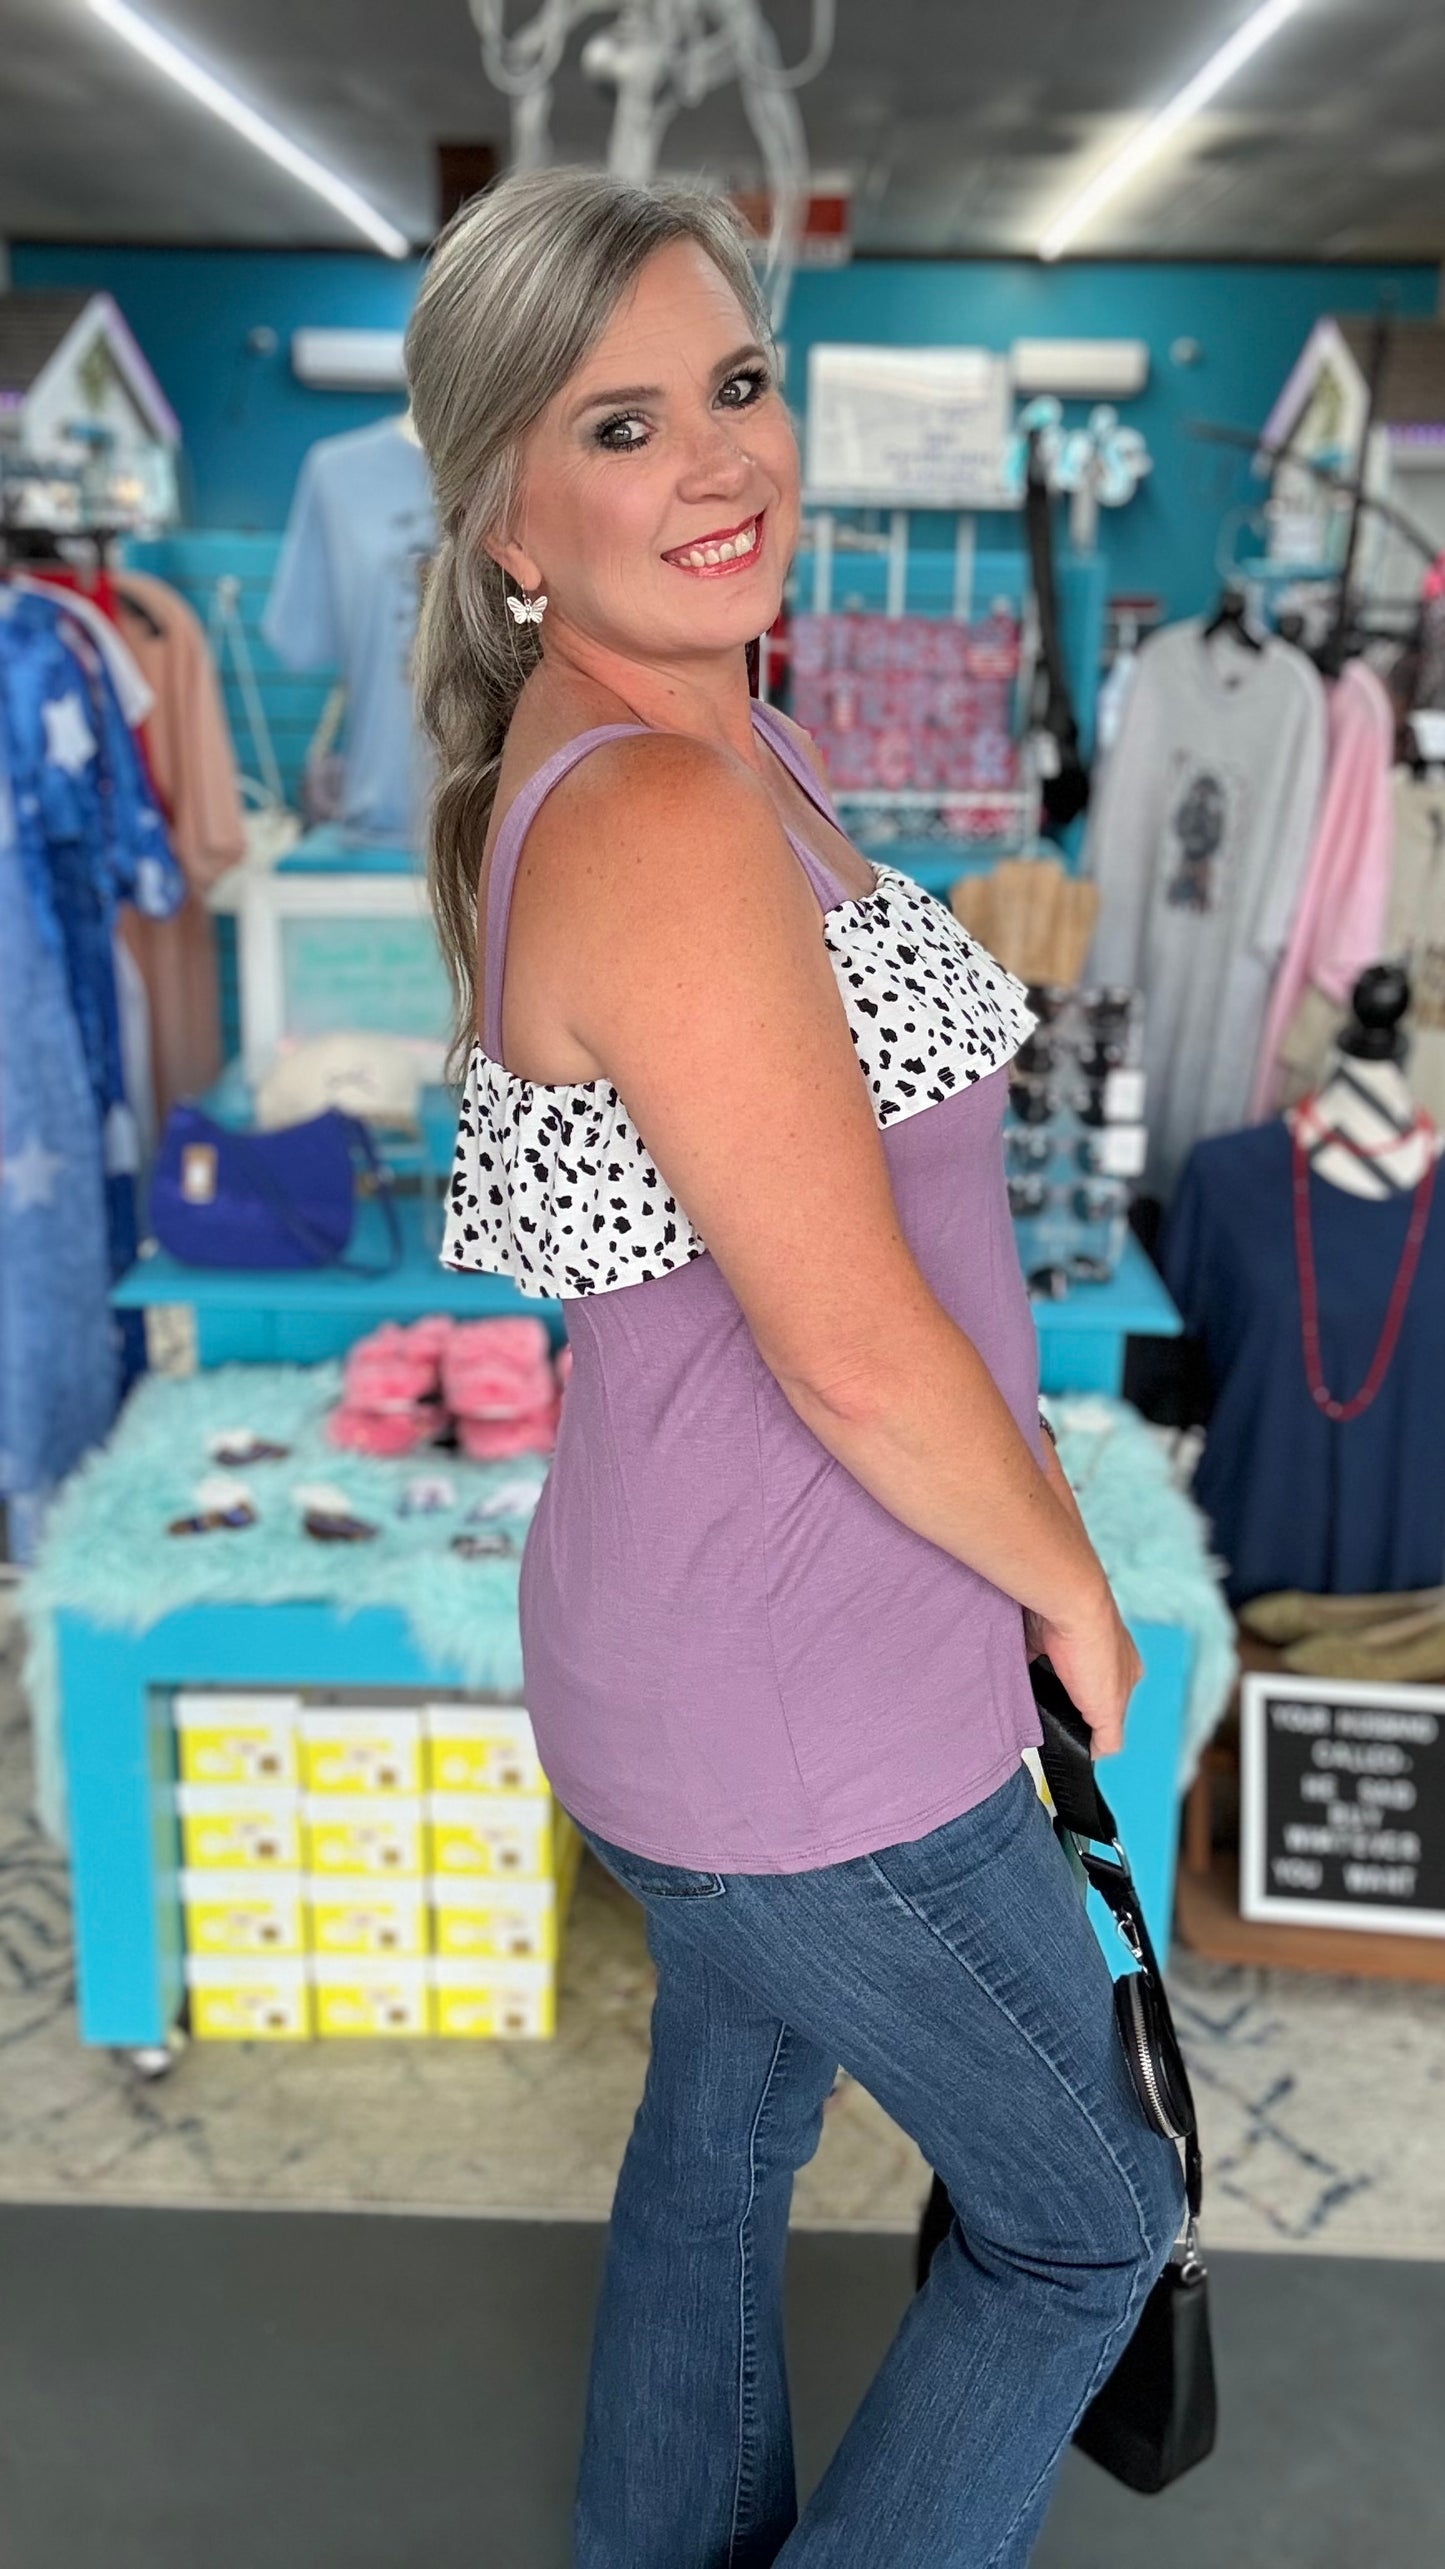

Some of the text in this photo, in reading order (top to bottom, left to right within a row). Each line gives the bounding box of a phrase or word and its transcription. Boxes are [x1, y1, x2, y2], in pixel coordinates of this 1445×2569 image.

[1272, 1705, 1438, 1744] YOUR HUSBAND
[1301, 1773, 1416, 1809] HE SAID
[1328, 1802, 1382, 1829] BUY
[1284, 1824, 1420, 1860] WHATEVER
[1272, 1857, 1417, 1896] YOU WANT
